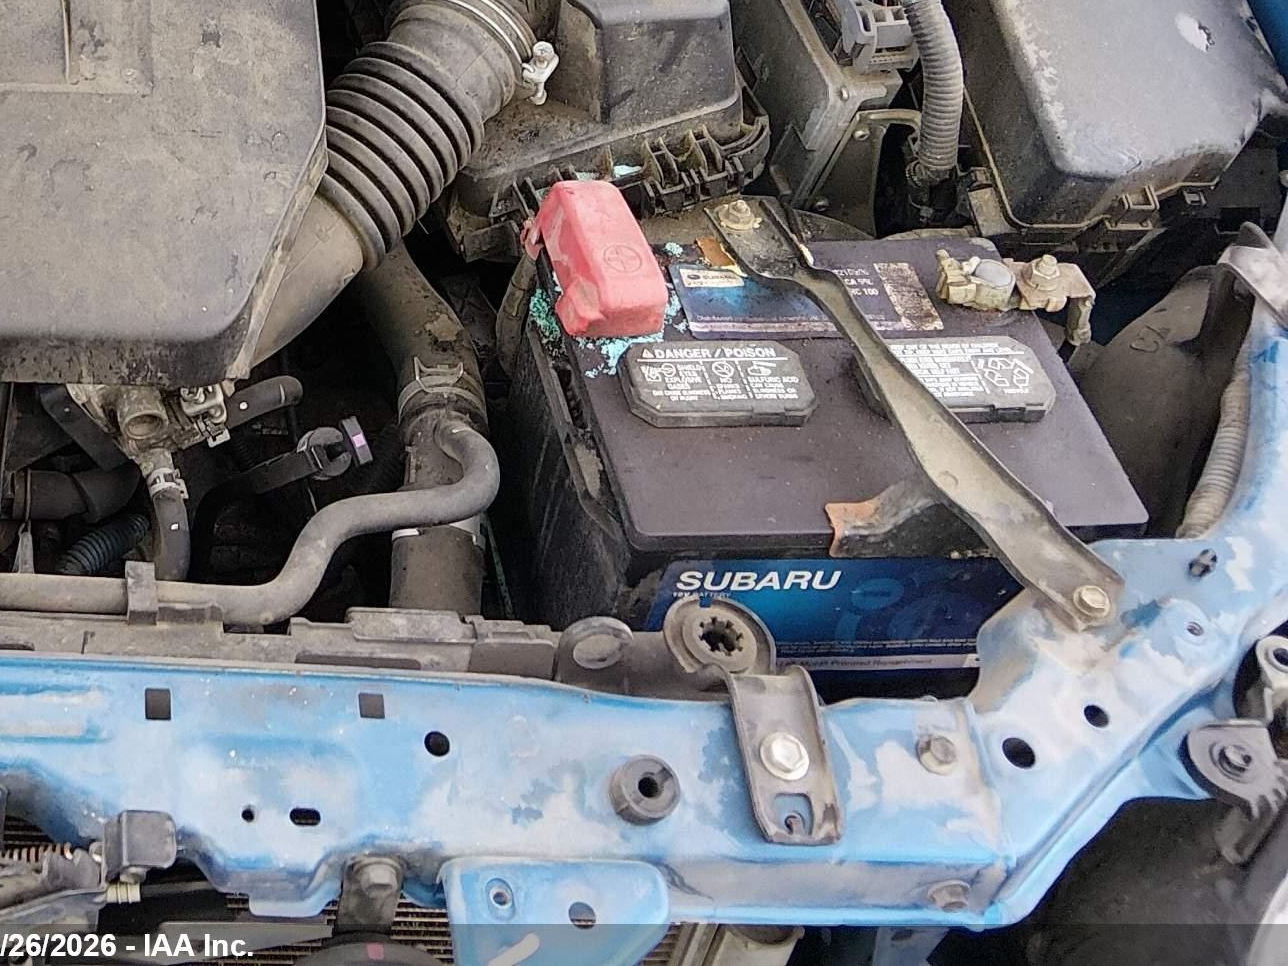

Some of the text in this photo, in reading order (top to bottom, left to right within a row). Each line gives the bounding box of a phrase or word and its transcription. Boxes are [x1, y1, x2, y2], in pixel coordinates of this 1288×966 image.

[654, 347, 776, 359] DANGER / POISON
[675, 570, 842, 592] SUBARU
